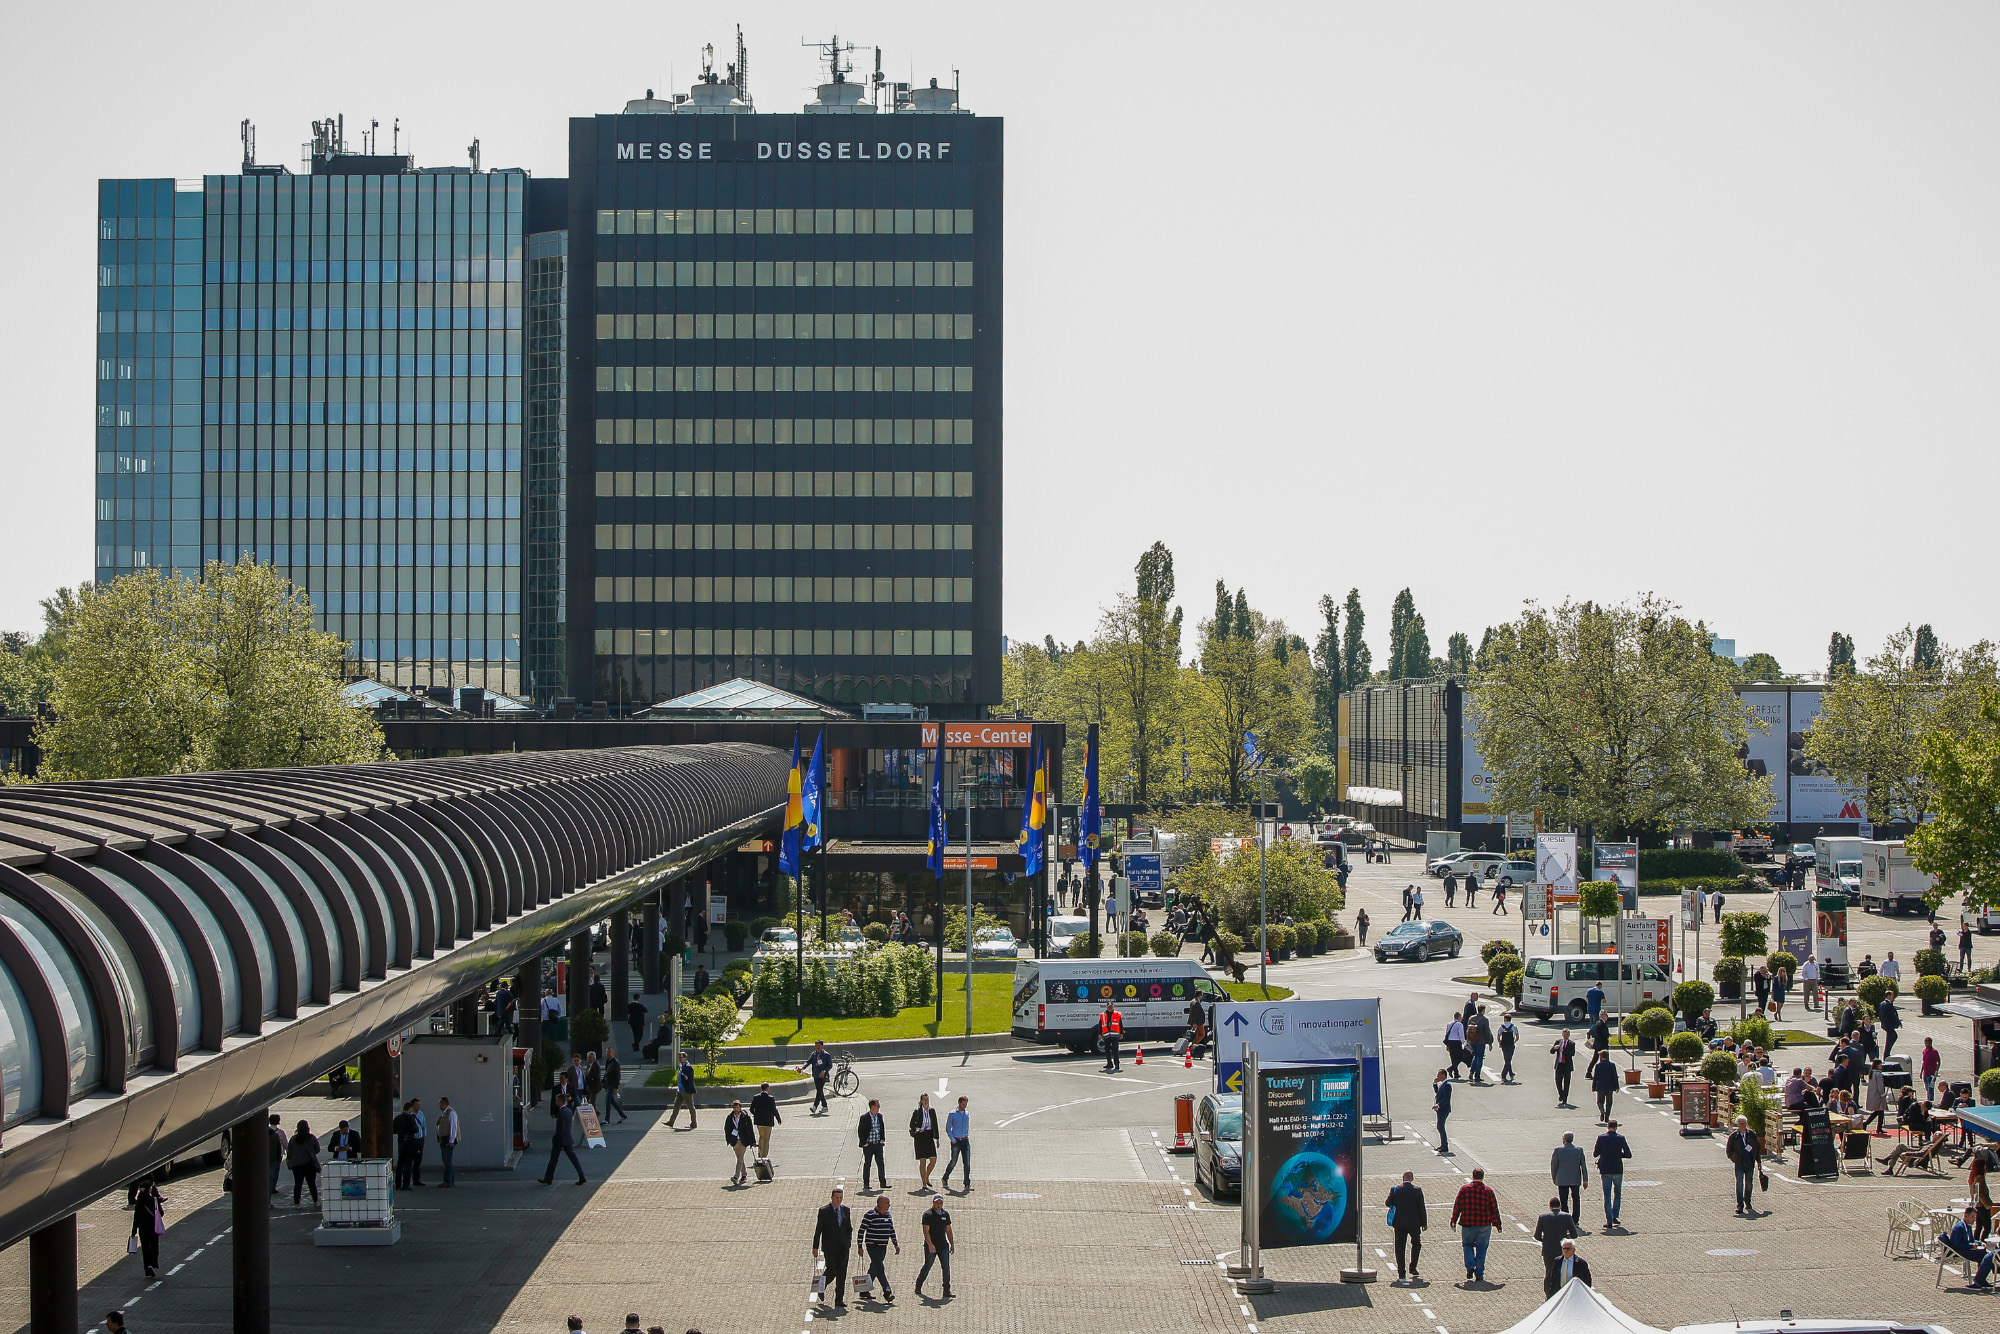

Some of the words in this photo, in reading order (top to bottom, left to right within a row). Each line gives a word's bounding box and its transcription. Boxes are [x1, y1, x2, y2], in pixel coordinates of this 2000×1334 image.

[616, 142, 713, 160] MESSE
[756, 141, 952, 160] DÜSSELDORF
[921, 728, 1033, 744] Msse-Center
[1298, 1017, 1364, 1030] innovationparc
[1266, 1077, 1305, 1090] Turkey
[1323, 1081, 1349, 1090] TURKISH
[1268, 1091, 1295, 1099] Discover
[1279, 1098, 1306, 1108] potential
